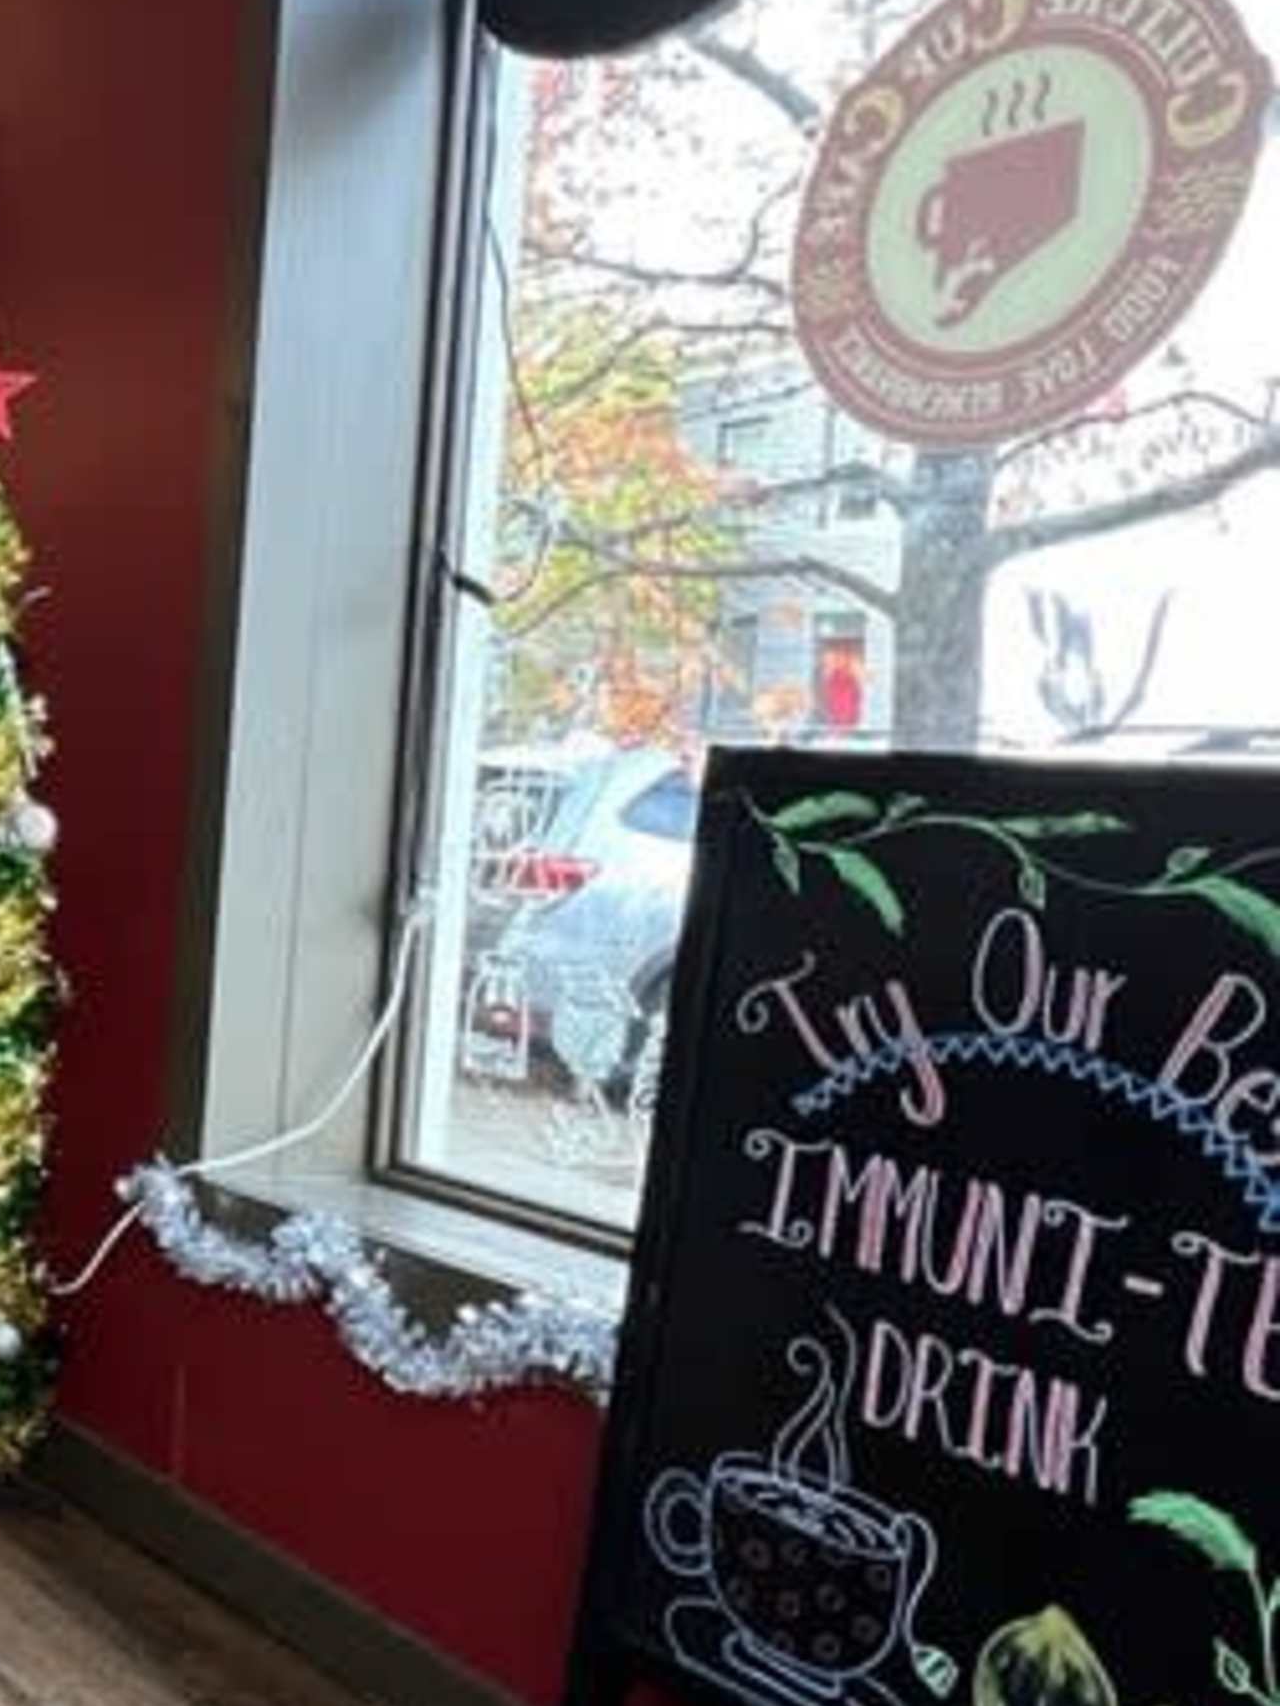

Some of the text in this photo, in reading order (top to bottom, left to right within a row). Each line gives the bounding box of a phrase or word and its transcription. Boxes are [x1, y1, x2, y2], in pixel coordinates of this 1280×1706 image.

[737, 951, 944, 1125] Try
[973, 907, 1127, 1048] Our
[862, 1316, 1105, 1506] DRINK
